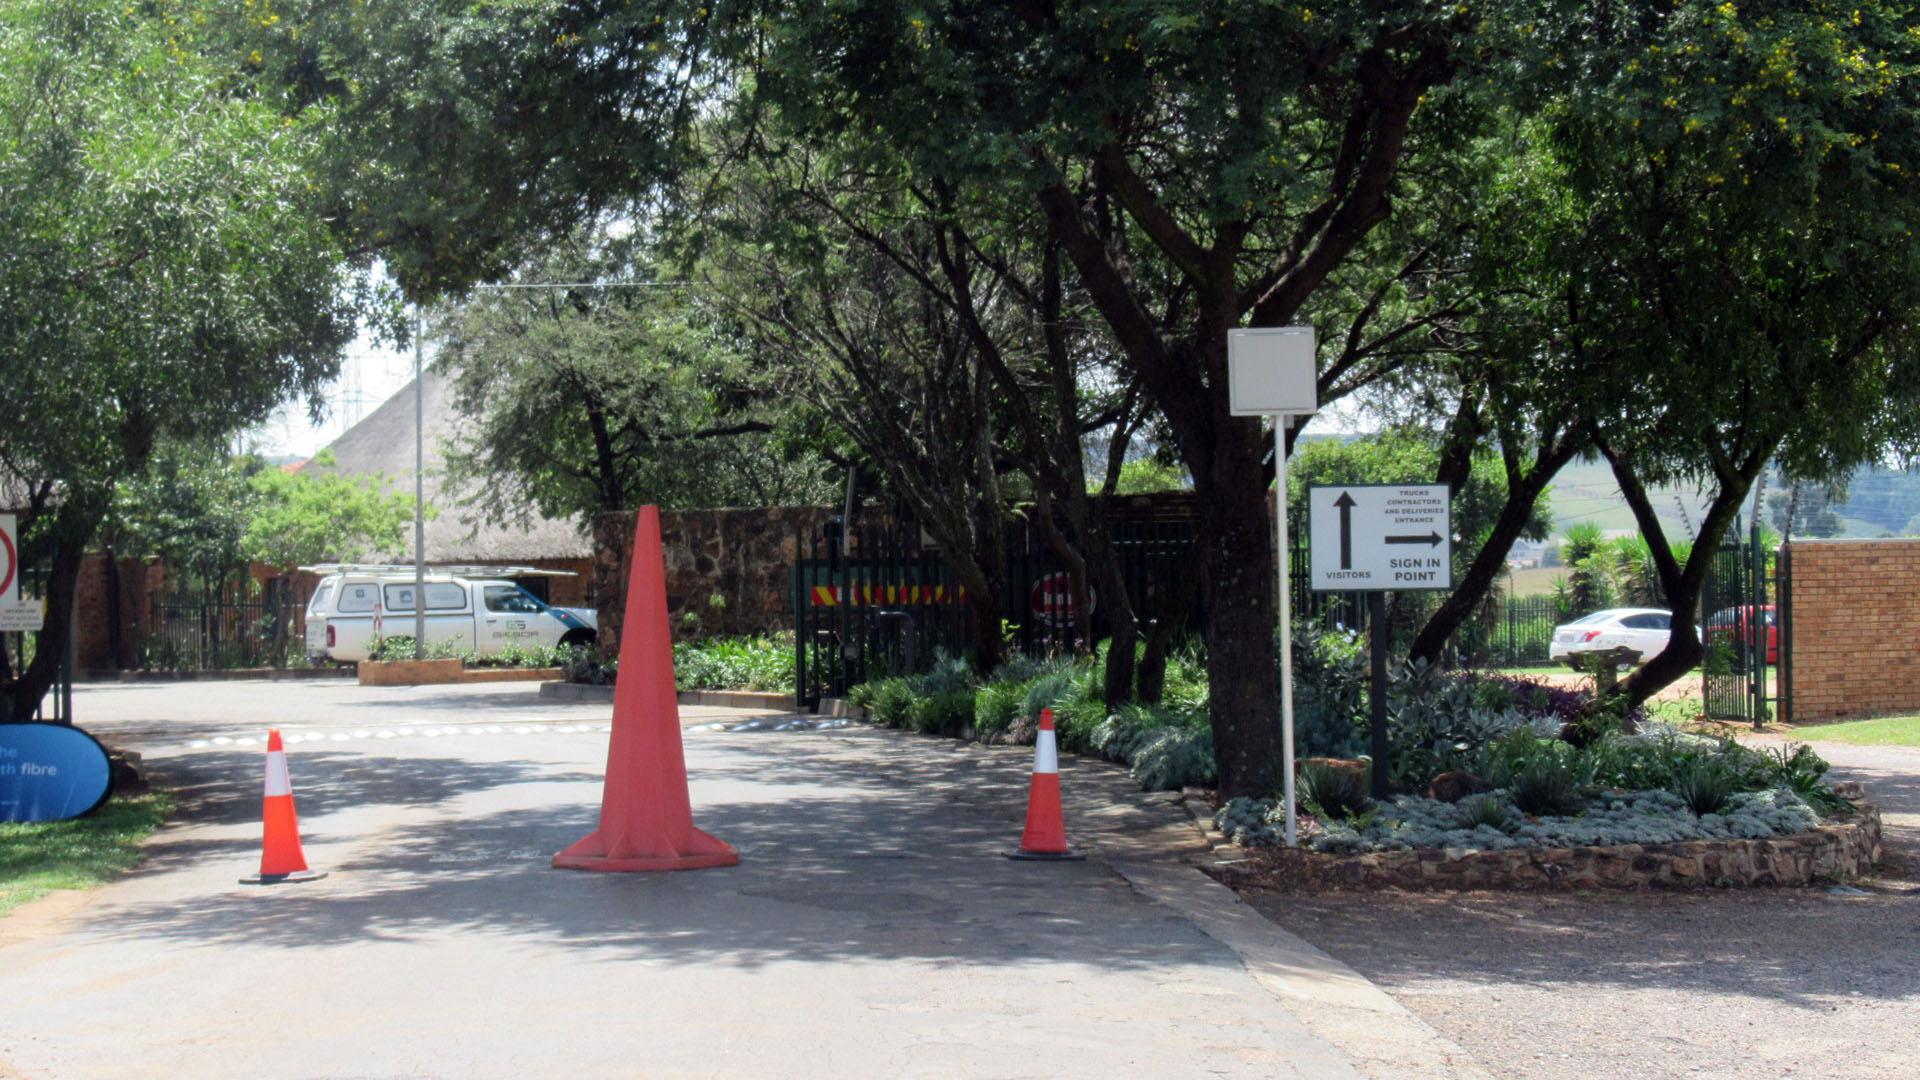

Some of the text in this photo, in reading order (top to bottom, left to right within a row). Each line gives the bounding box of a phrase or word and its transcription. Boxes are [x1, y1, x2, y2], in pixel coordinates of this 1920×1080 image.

[1389, 558, 1441, 568] SIGN IN
[1326, 571, 1372, 579] VISITORS
[1394, 571, 1437, 581] POINT
[20, 761, 58, 776] fibre
